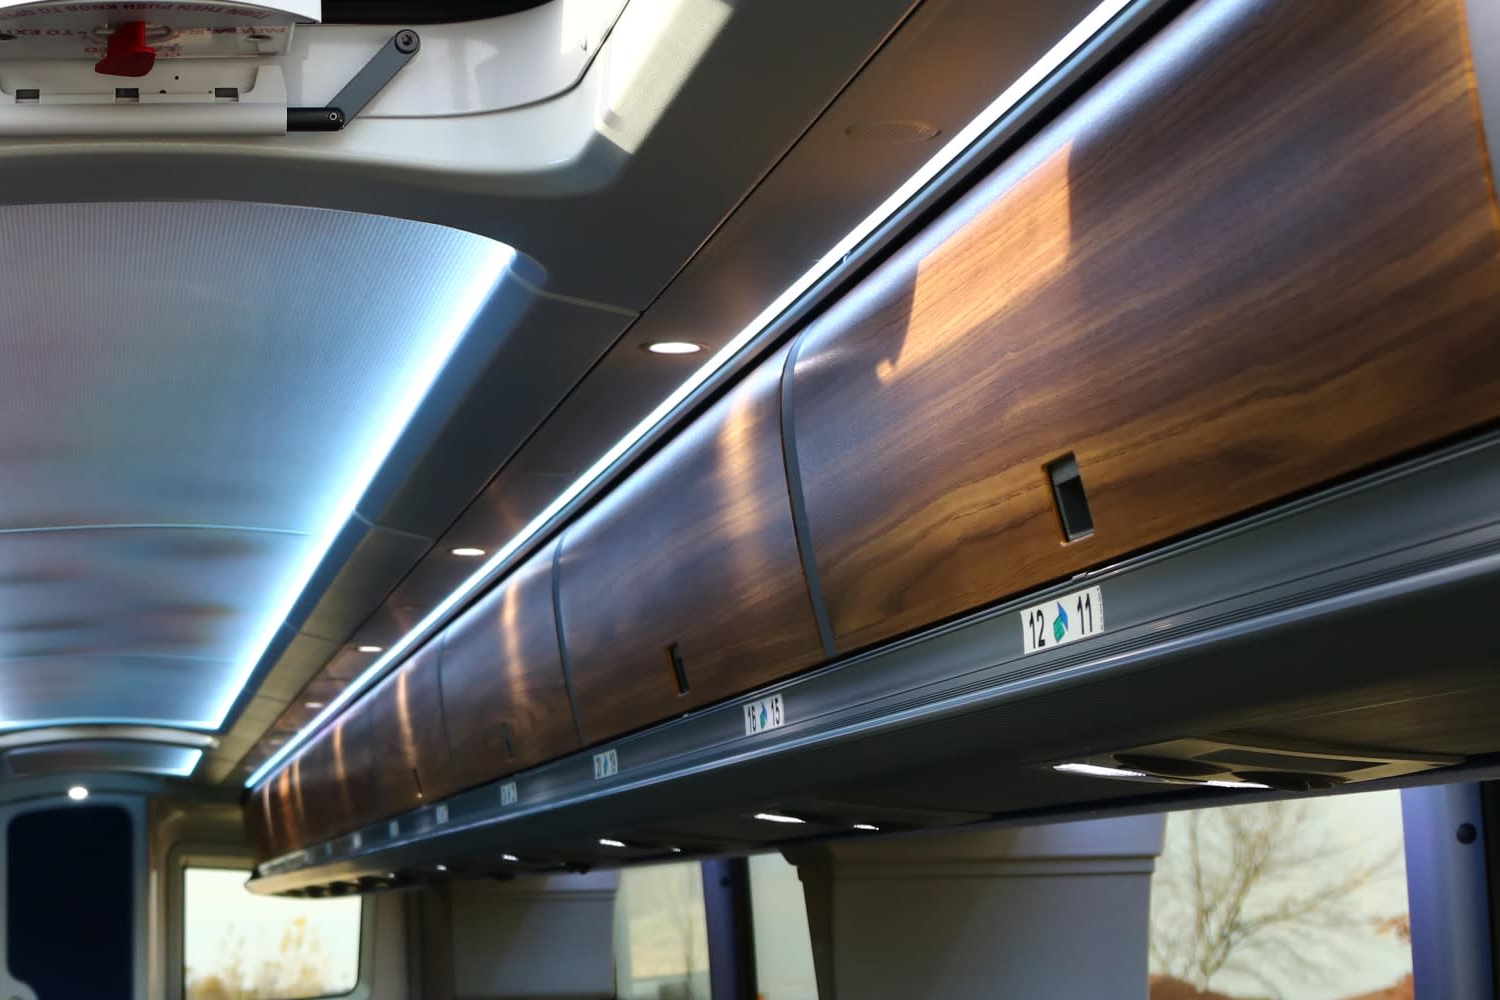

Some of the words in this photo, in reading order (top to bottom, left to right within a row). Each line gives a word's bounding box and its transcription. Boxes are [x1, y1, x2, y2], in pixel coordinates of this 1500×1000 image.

[1029, 608, 1046, 650] 12
[1076, 592, 1093, 636] 11
[747, 705, 757, 734] 16
[770, 697, 781, 727] 15
